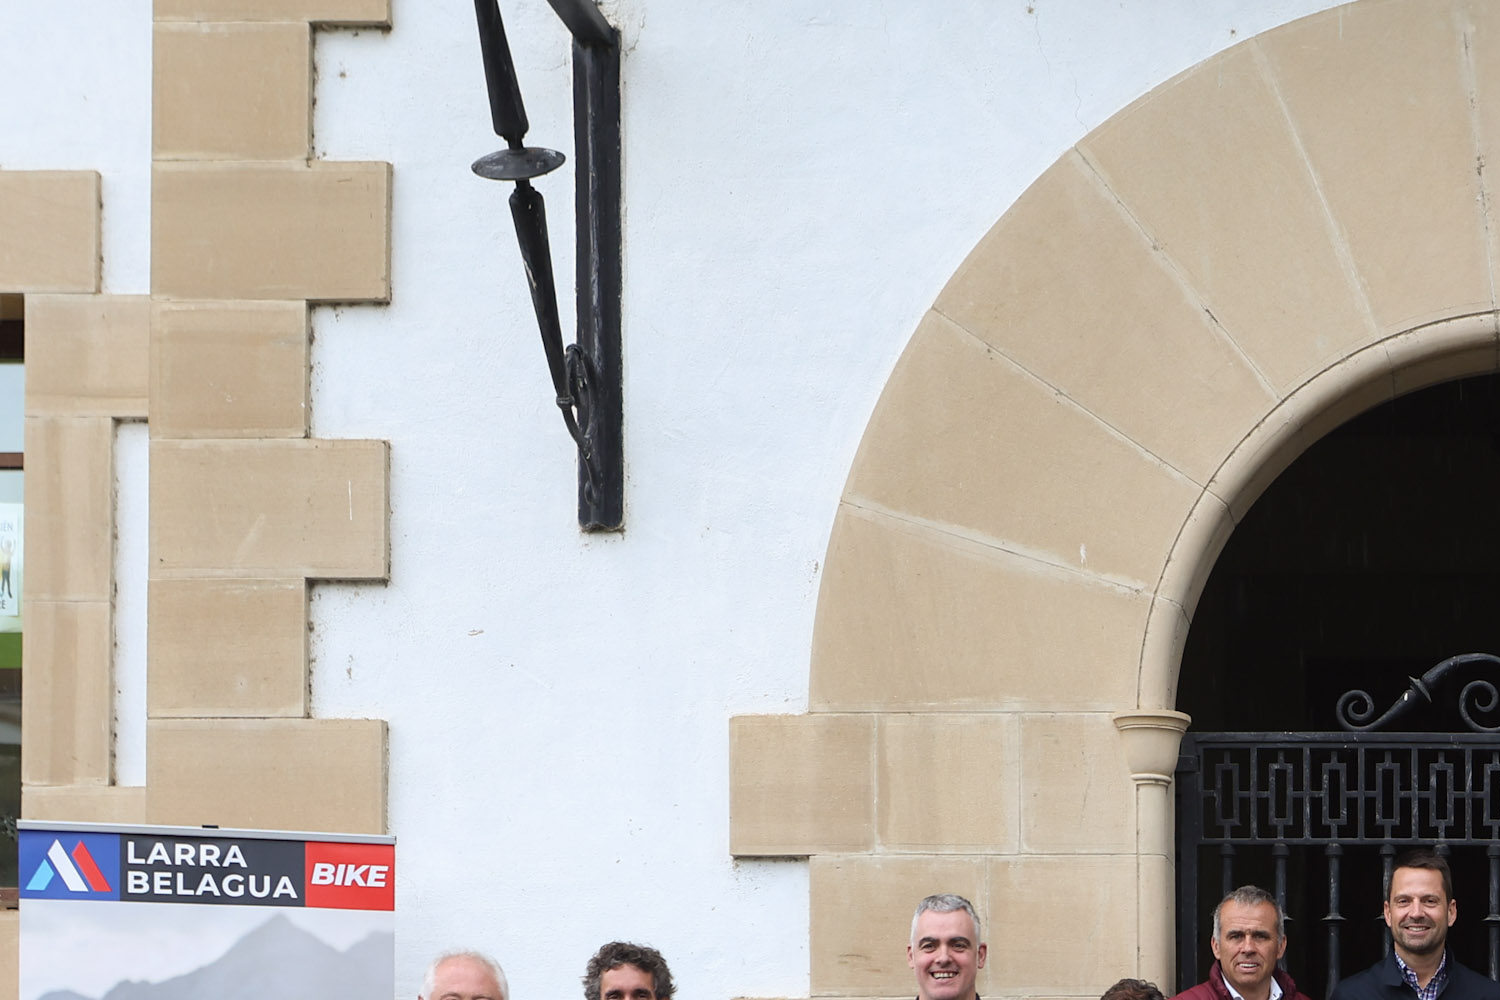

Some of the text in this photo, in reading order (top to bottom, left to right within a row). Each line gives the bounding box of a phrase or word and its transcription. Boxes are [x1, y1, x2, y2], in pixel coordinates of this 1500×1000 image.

[127, 840, 248, 868] LARRA
[127, 870, 298, 899] BELAGUA
[311, 862, 389, 888] BIKE
